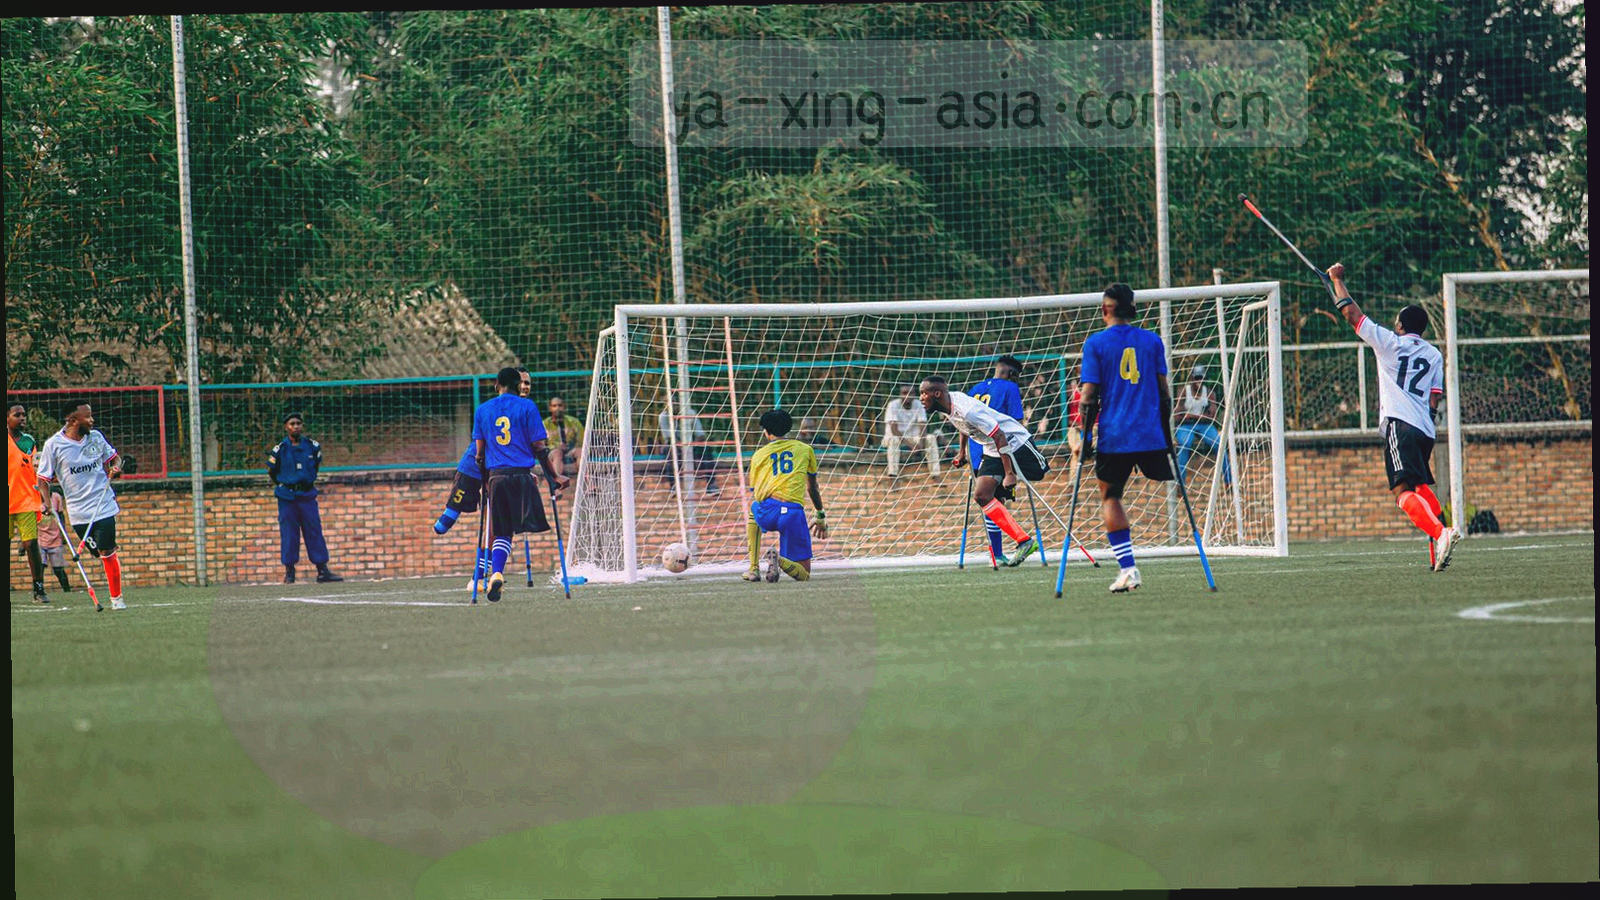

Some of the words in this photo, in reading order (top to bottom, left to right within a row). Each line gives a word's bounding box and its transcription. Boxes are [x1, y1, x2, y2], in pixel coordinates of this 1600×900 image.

[1120, 347, 1140, 384] 4
[1397, 355, 1431, 397] 12
[495, 416, 511, 446] 3
[770, 450, 794, 476] 16
[453, 488, 465, 503] 5
[86, 536, 97, 549] 8
